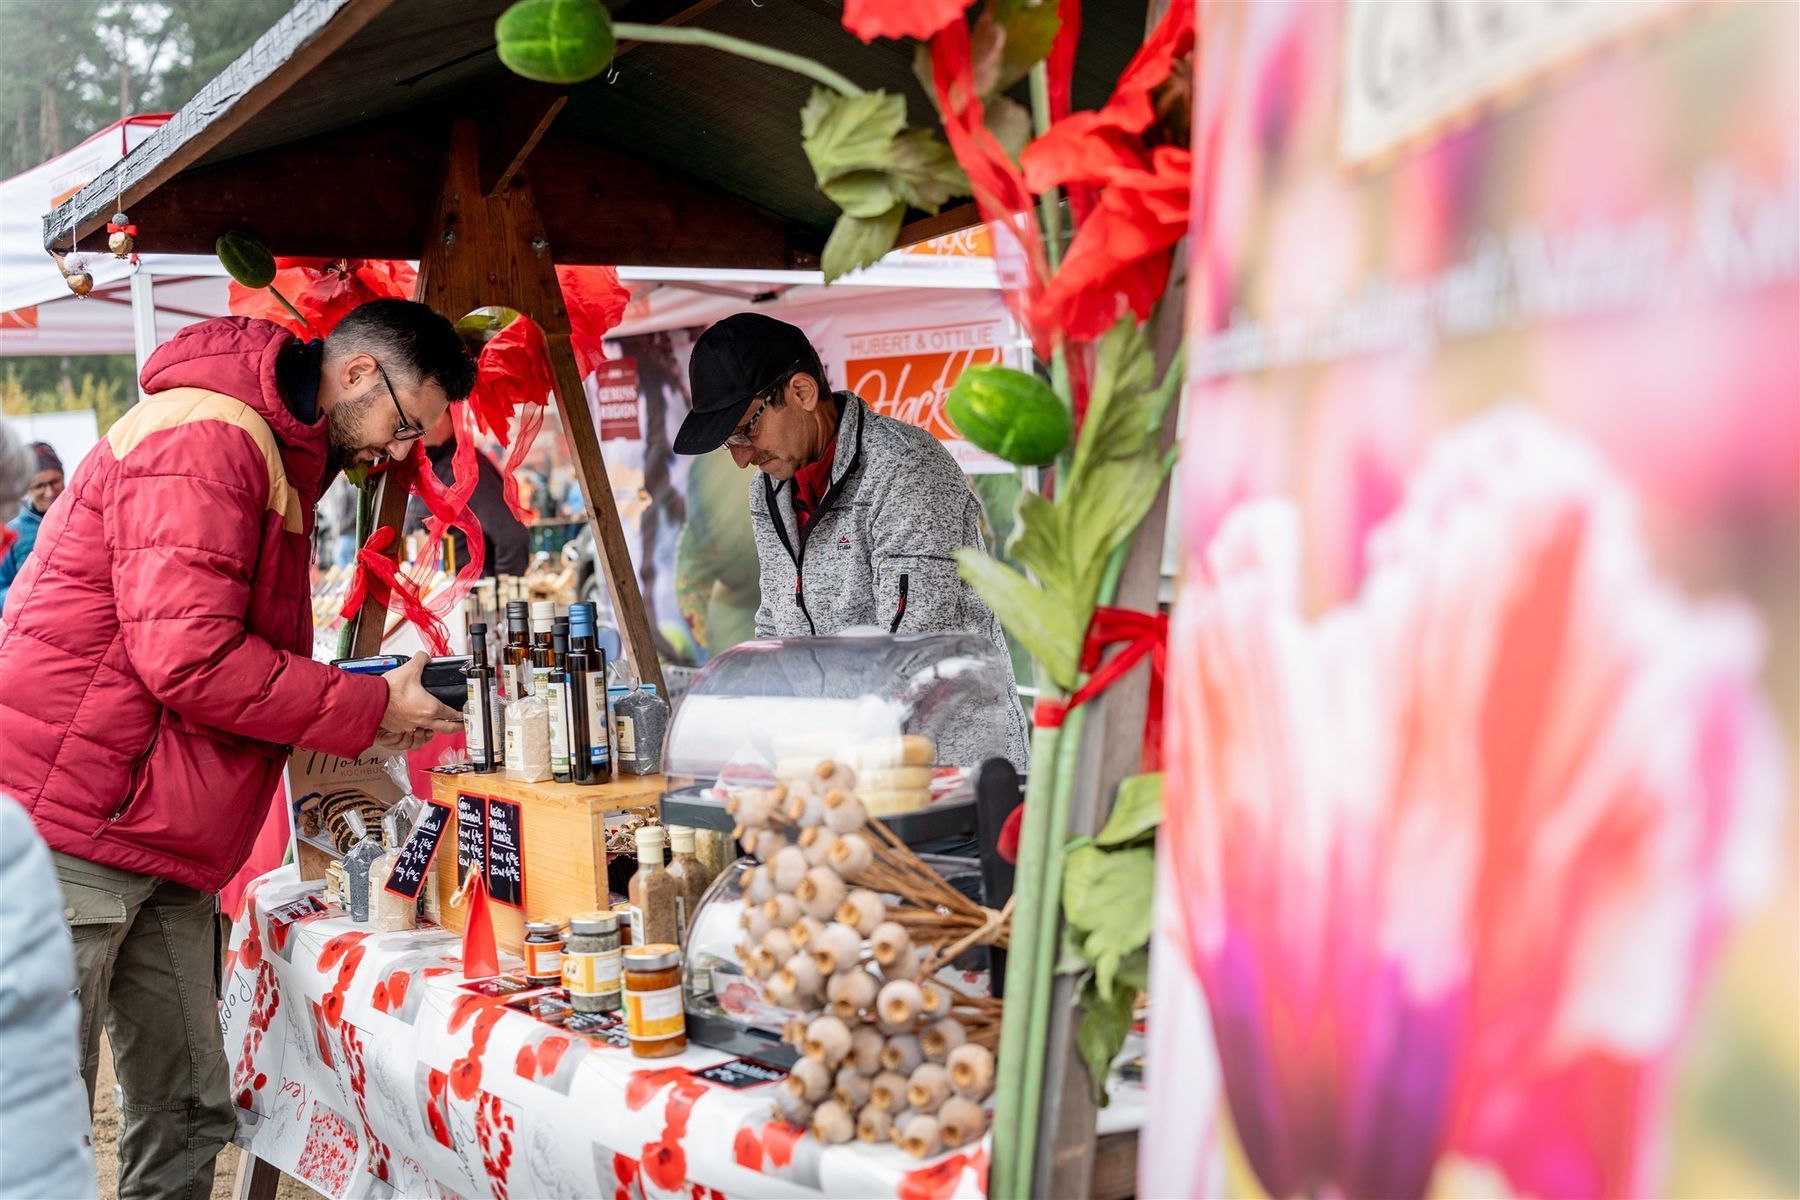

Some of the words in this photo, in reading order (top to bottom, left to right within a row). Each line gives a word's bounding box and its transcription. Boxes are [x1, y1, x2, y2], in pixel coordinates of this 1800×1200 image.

[851, 335, 910, 354] HUBERT
[916, 337, 926, 350] &
[930, 326, 994, 350] OTTILIE
[341, 766, 389, 778] KOCHBUC
